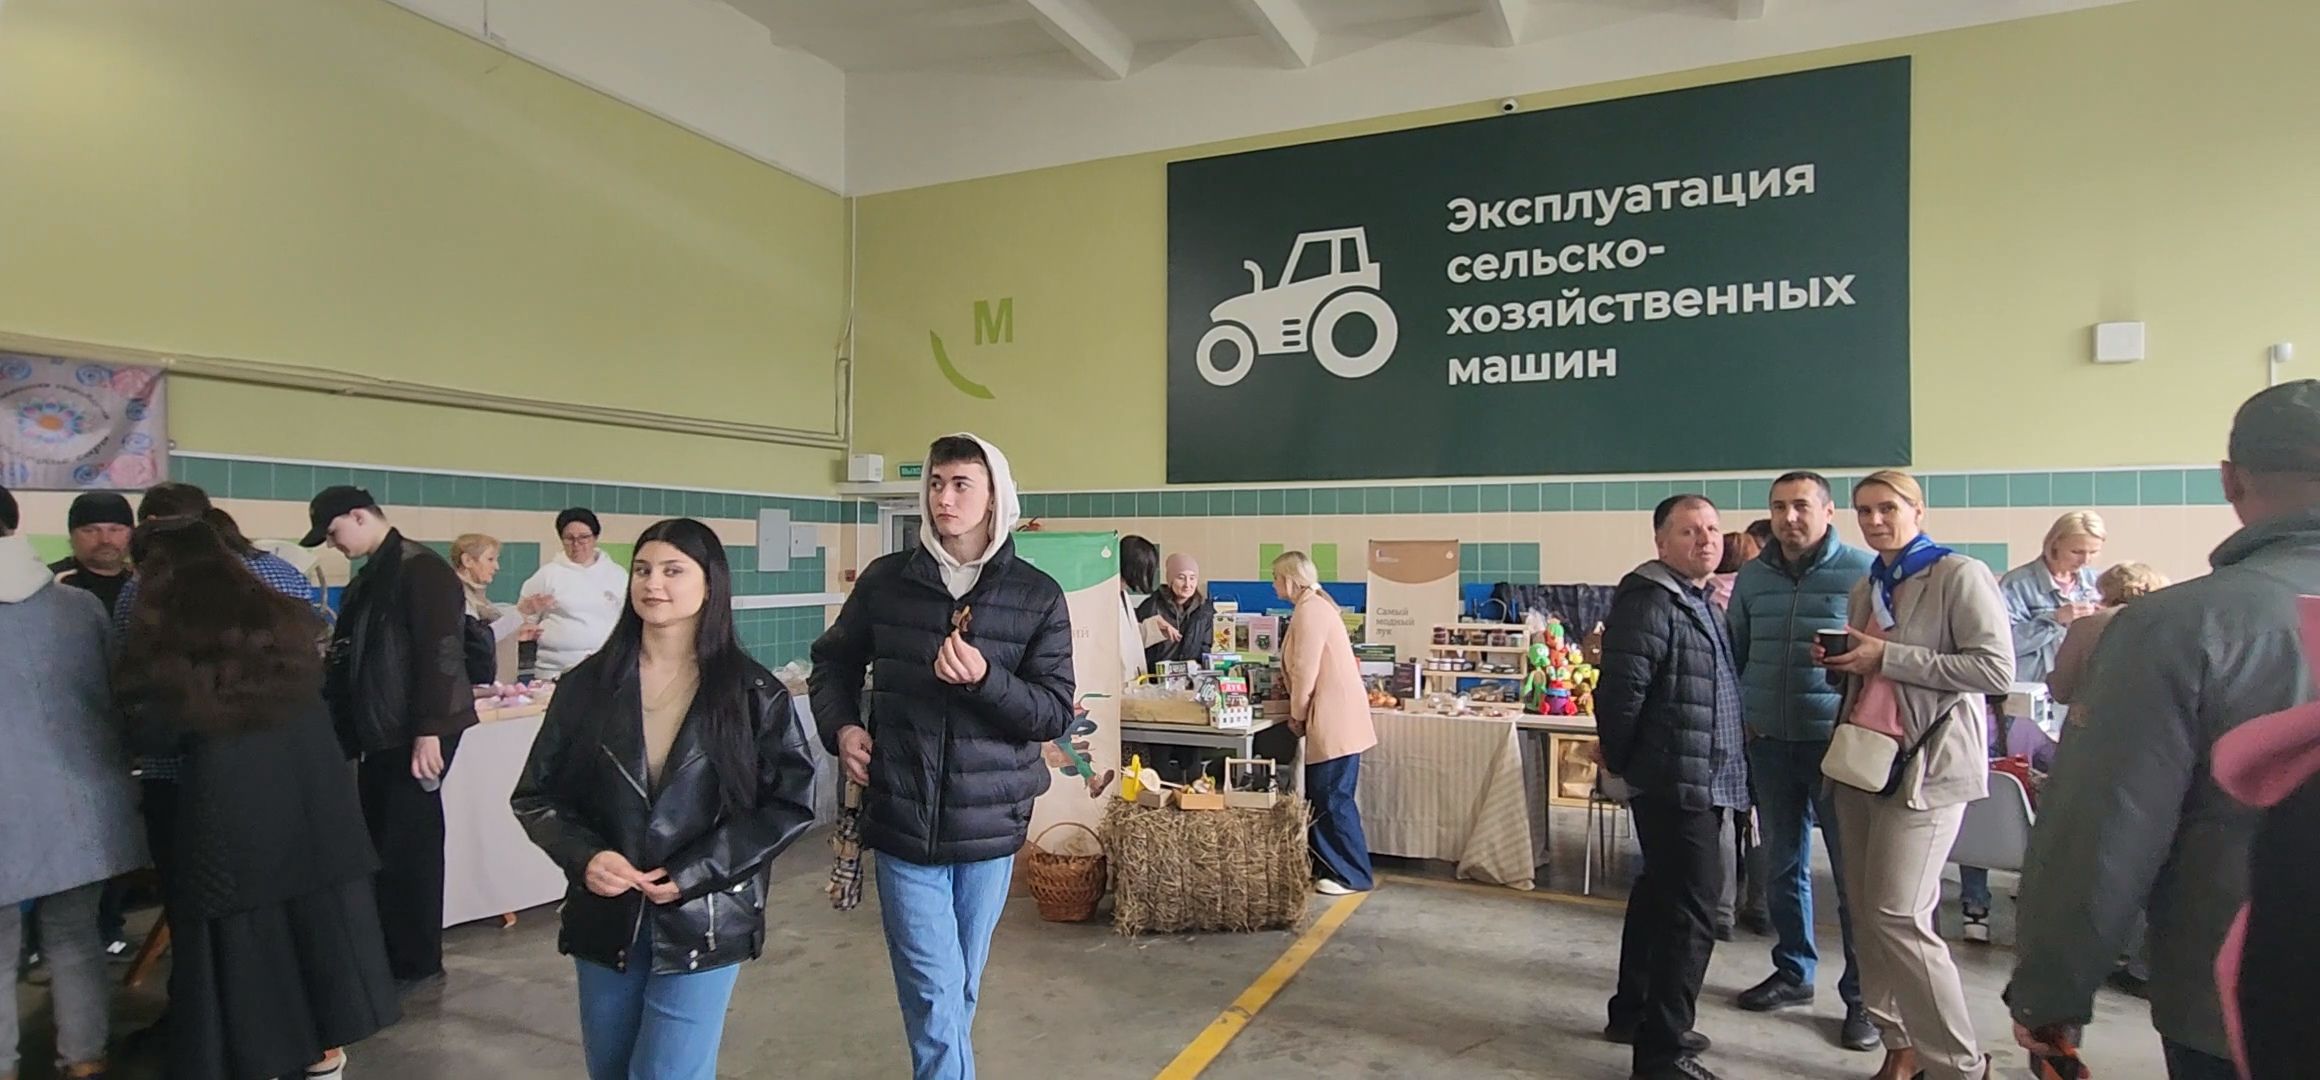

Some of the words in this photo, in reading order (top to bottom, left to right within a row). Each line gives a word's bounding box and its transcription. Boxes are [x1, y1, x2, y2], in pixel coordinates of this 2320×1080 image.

[1447, 163, 1815, 232] Эксплуатация
[1447, 238, 1666, 283] сельско-
[1447, 274, 1856, 335] хозяйственных
[1447, 347, 1617, 386] машин
[1375, 617, 1415, 626] модный
[1376, 607, 1409, 616] Самый
[1376, 628, 1392, 638] лук
